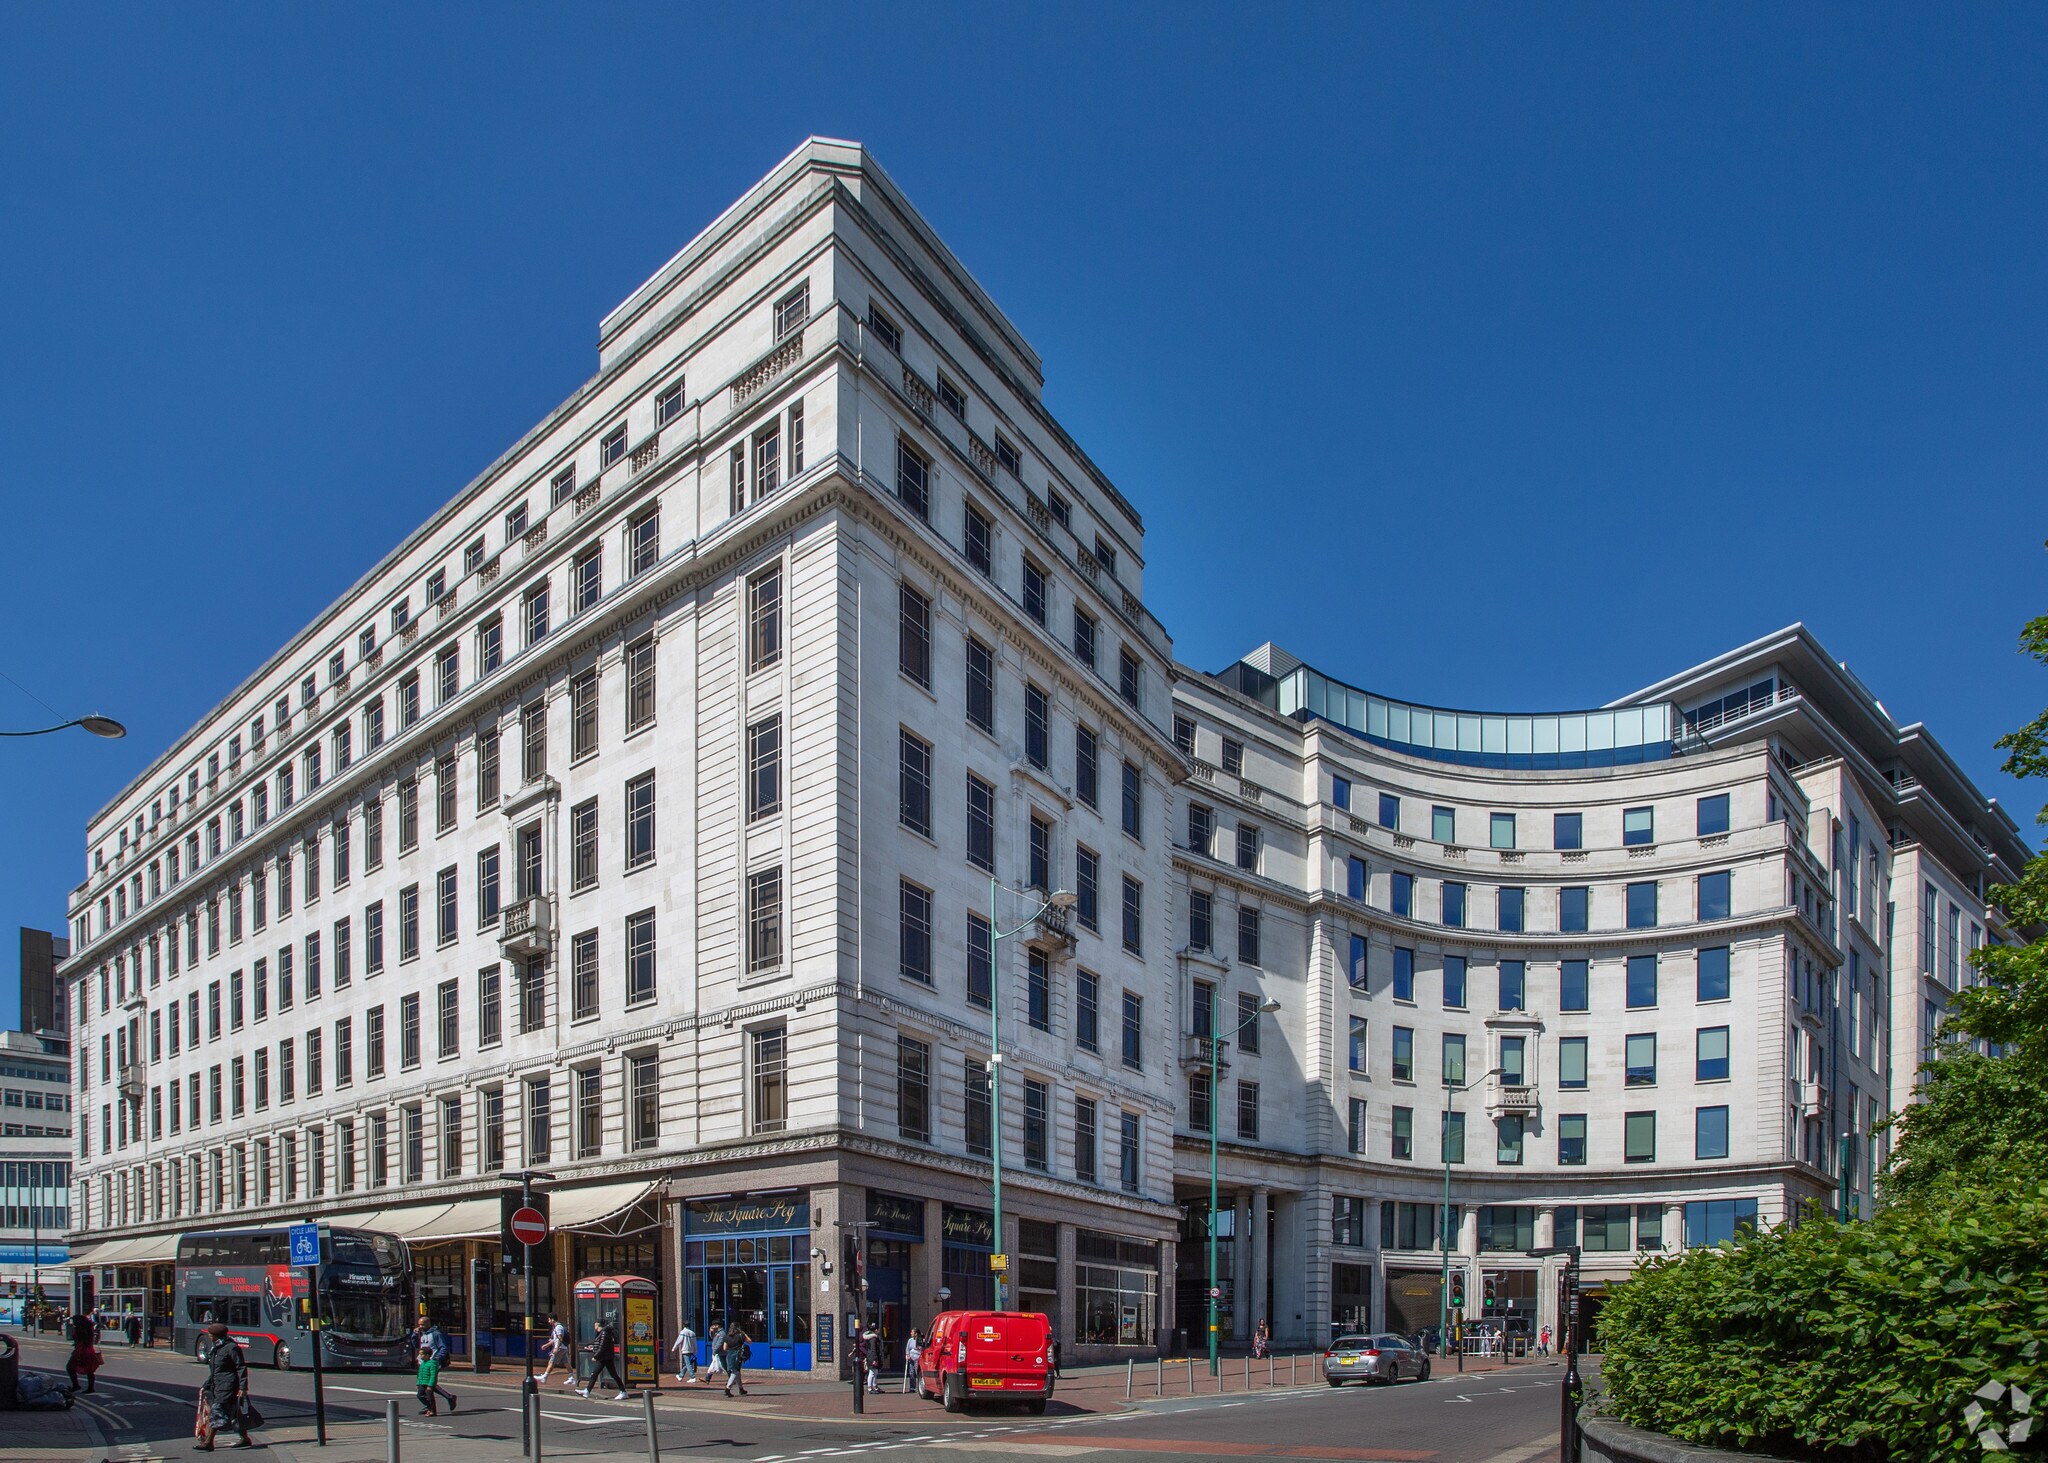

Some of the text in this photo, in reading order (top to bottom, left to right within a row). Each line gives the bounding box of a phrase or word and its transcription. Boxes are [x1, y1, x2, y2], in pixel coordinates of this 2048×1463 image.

[702, 1198, 796, 1227] The Square Peg
[291, 1227, 304, 1235] CYCLE
[944, 1214, 992, 1240] Square Peg
[293, 1254, 318, 1263] LOOK RIGHT
[382, 1275, 394, 1287] X4
